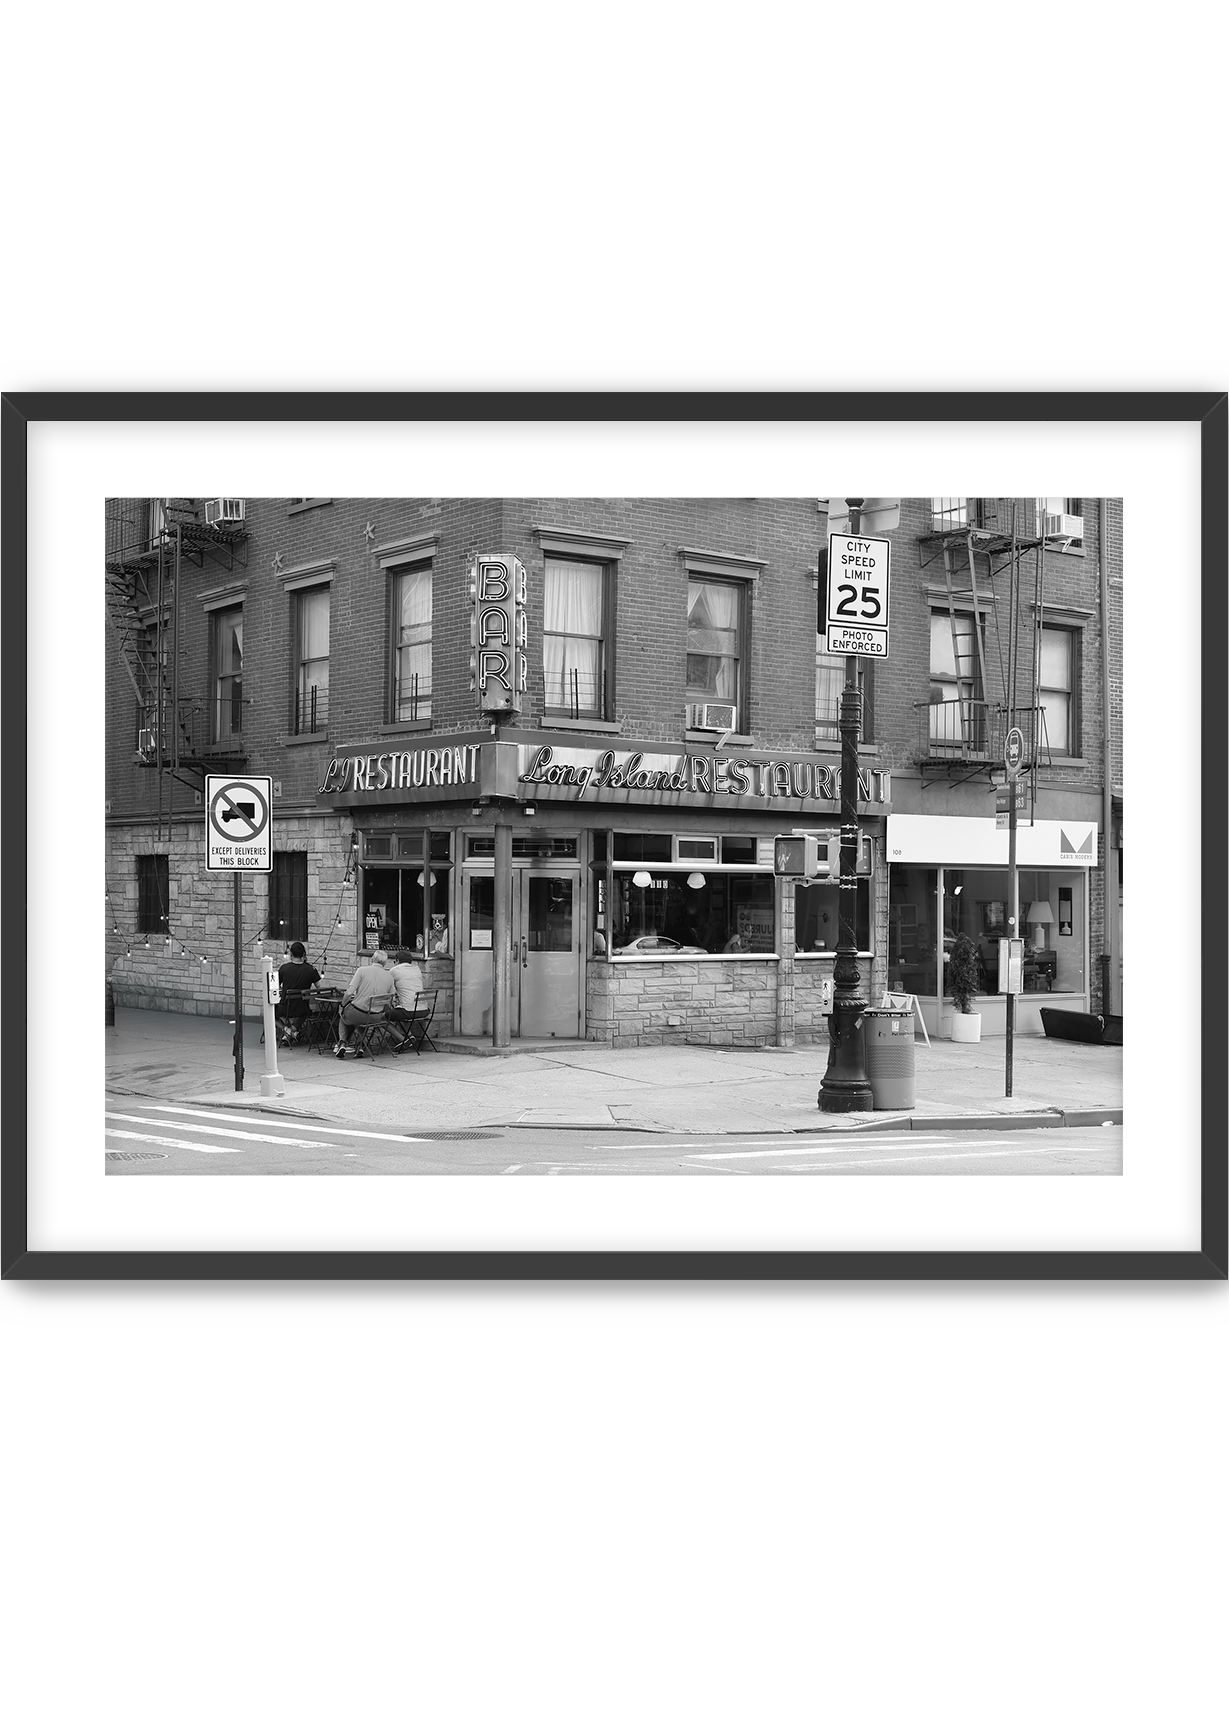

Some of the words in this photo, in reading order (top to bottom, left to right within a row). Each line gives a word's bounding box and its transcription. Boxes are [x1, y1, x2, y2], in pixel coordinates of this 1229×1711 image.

[847, 542, 871, 553] CITY
[841, 554, 876, 568] SPEED
[844, 569, 872, 580] LIMIT
[836, 584, 881, 619] 25
[479, 562, 512, 690] BAR
[842, 631, 873, 641] PHOTO
[832, 640, 883, 652] ENFORCED
[353, 744, 480, 791] RESTAURANT
[523, 745, 593, 800] Long
[595, 749, 689, 791] Island
[211, 846, 233, 855] EXCEPT
[234, 847, 267, 856] DELIVERIES
[219, 857, 235, 866] THIS
[237, 857, 260, 866] BLOCK
